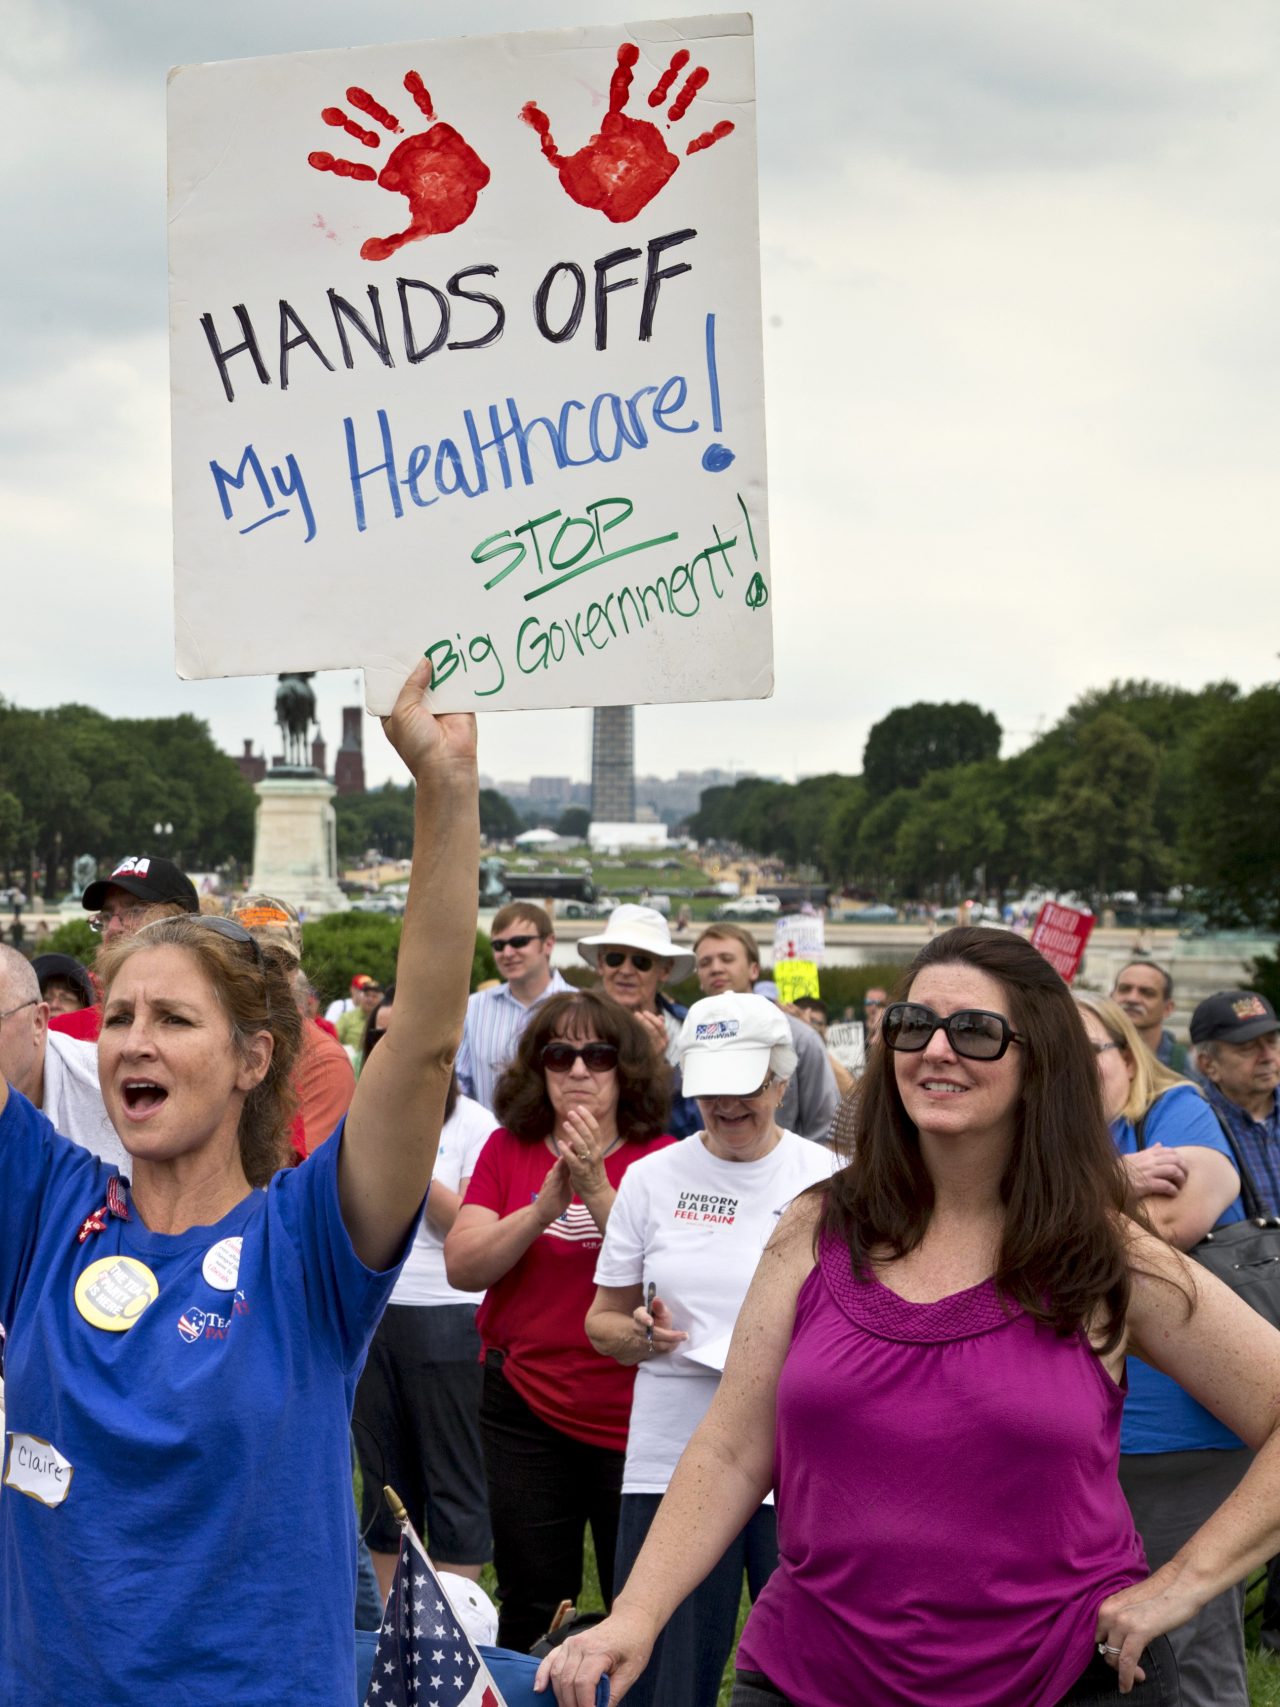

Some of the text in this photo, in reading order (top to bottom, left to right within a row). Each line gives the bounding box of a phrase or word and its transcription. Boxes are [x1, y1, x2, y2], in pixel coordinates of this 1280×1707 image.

[199, 229, 698, 402] HANDS OFF
[209, 313, 735, 543] My Healthcare!
[471, 497, 634, 590] STOP
[424, 493, 769, 697] Big Government!
[674, 1209, 699, 1221] FEEL
[677, 1200, 736, 1216] BABIES
[680, 1192, 738, 1207] UNBORN
[18, 1445, 63, 1482] Claire
